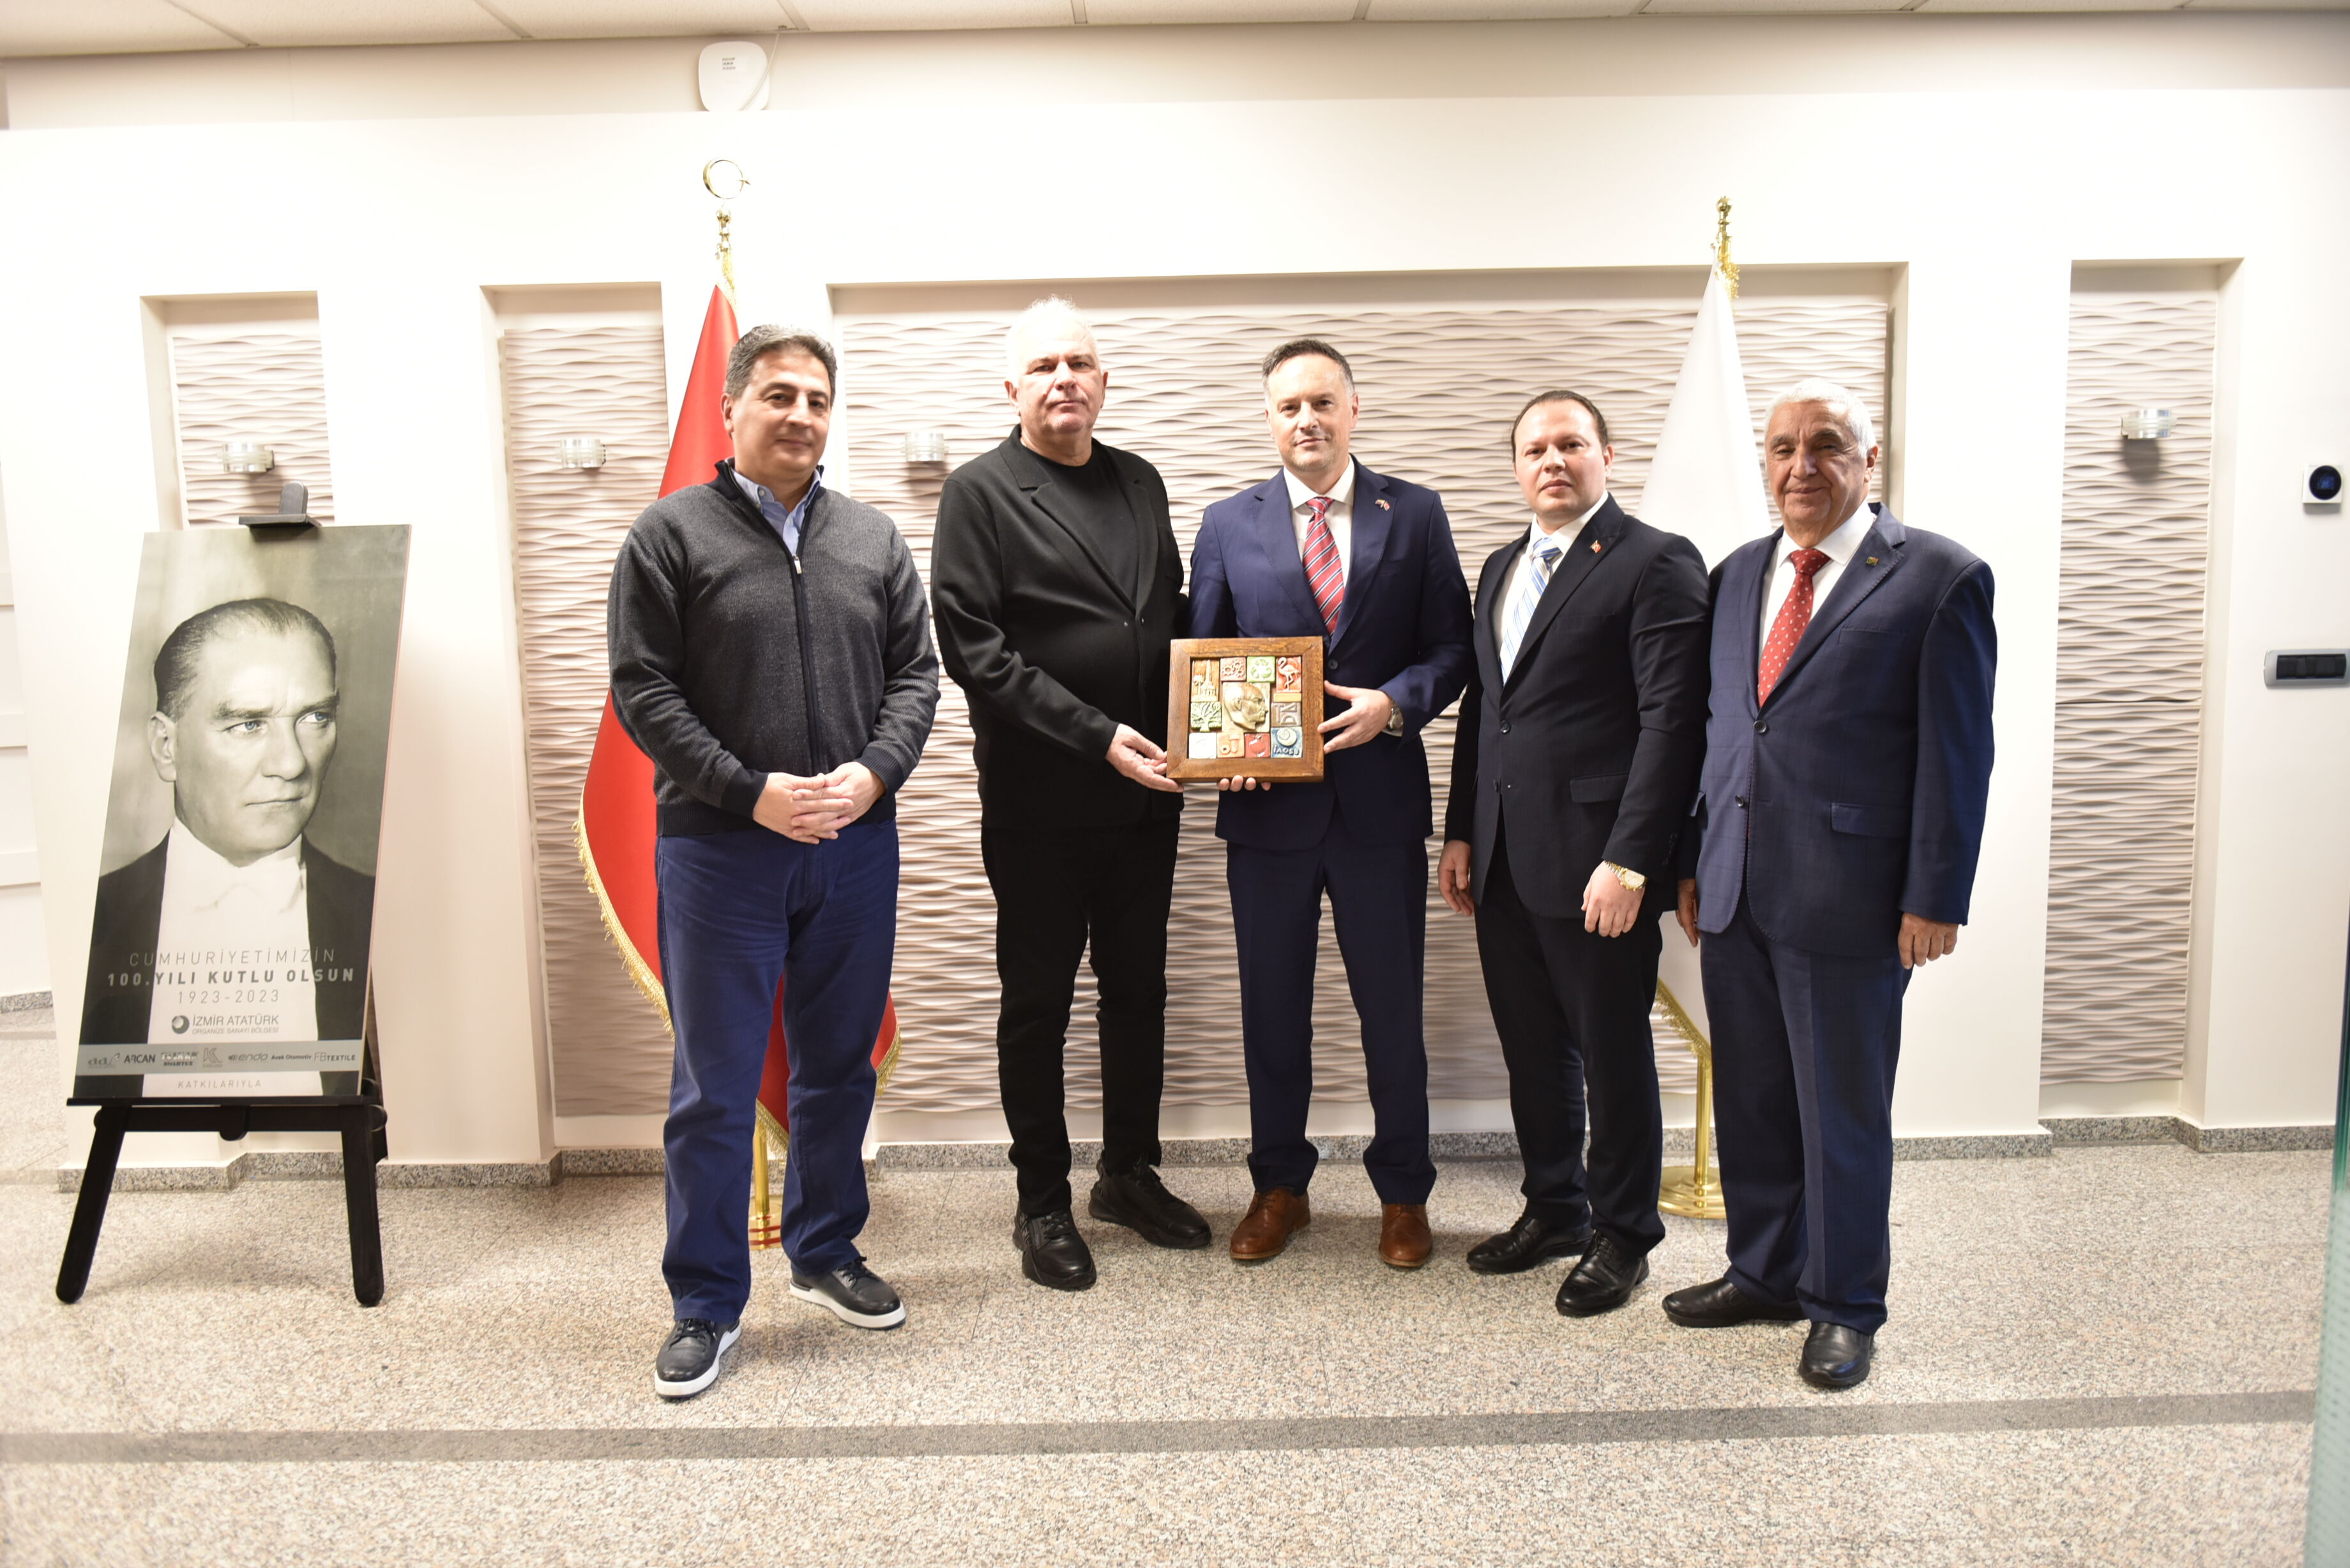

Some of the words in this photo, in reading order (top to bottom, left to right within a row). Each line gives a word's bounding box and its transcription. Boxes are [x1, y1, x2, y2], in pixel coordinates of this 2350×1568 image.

[130, 948, 335, 967] CUMHURİYETİMİZİN
[208, 970, 275, 984] KUTLU
[286, 968, 354, 983] OLSUN
[178, 989, 280, 1004] 1923-2023
[193, 1014, 224, 1027] İZMİR
[227, 1013, 279, 1025] ATATÜRK
[123, 1054, 156, 1064] ARCAN
[178, 1079, 261, 1089] KATKILARIYLA
